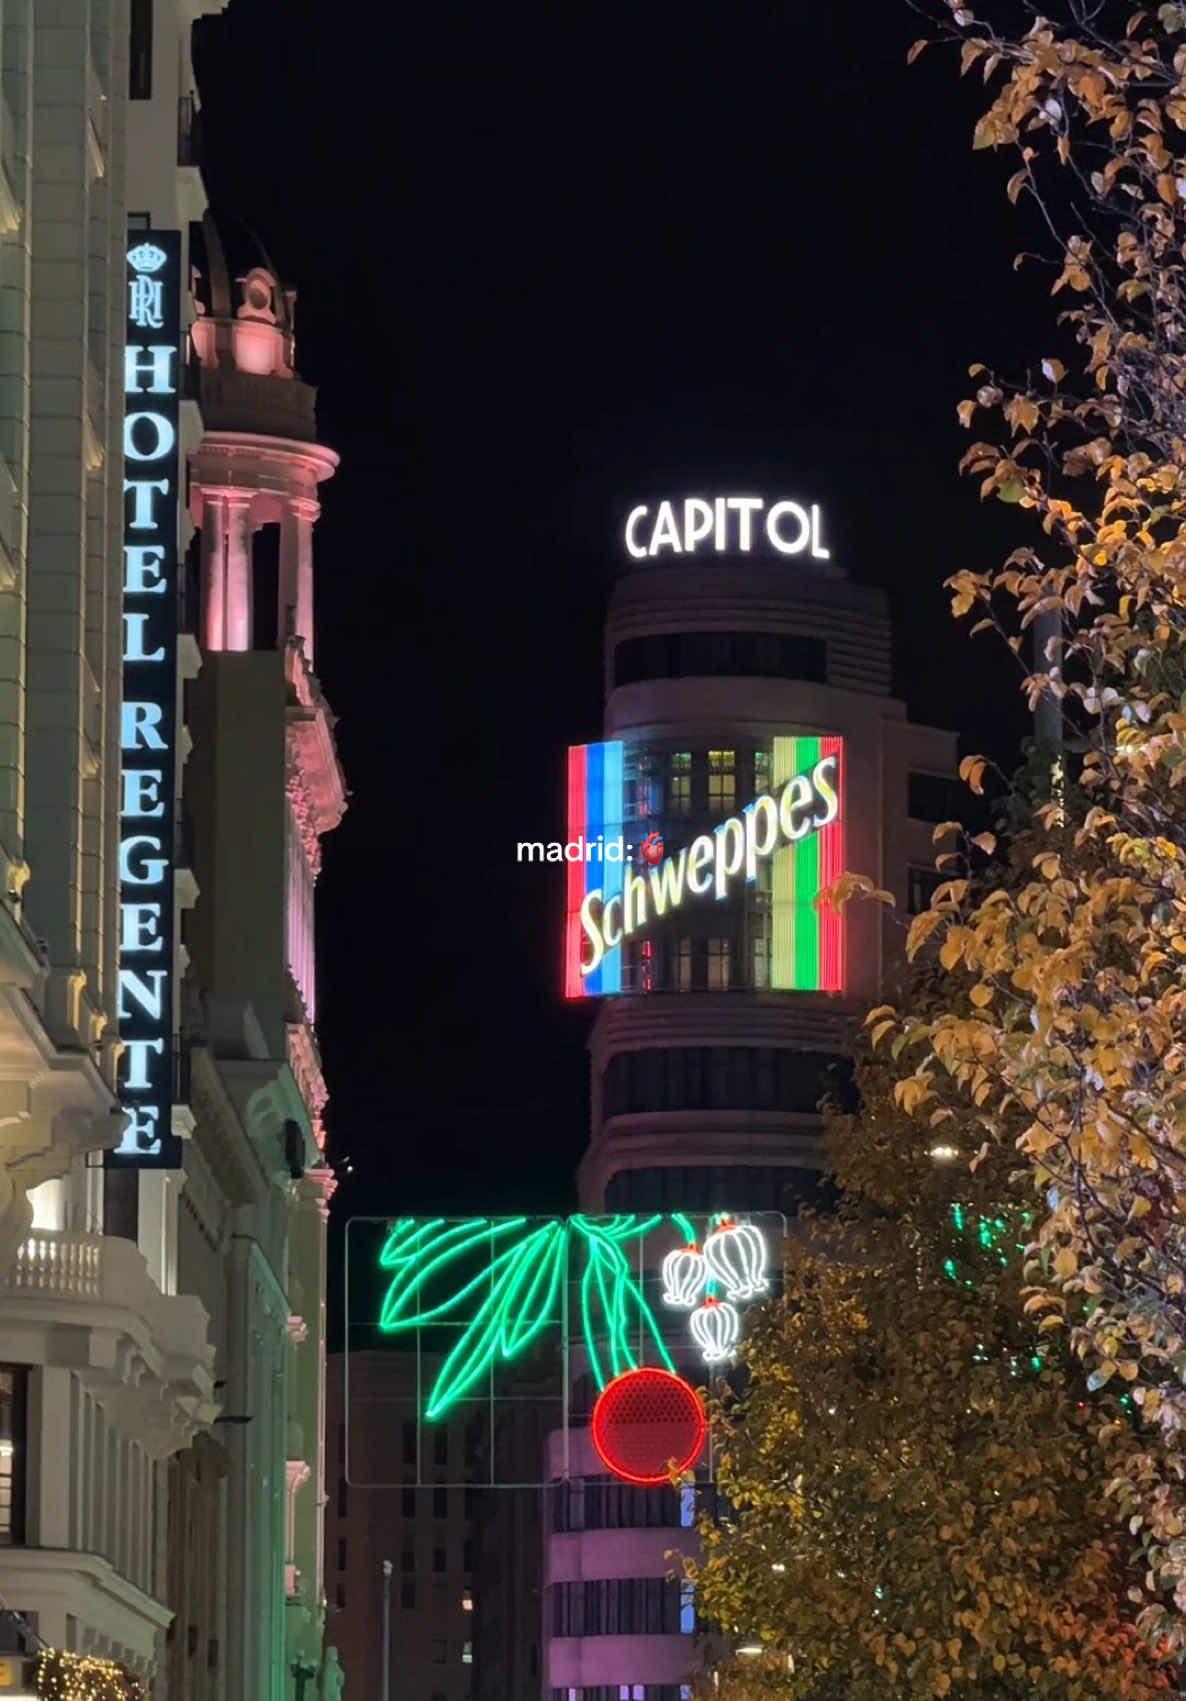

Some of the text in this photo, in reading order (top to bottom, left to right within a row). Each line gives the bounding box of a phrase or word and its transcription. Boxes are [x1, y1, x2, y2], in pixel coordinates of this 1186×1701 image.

[625, 497, 830, 559] CAPITOL
[114, 344, 178, 1156] HOTEL REGENTE
[580, 755, 839, 976] Schweppes
